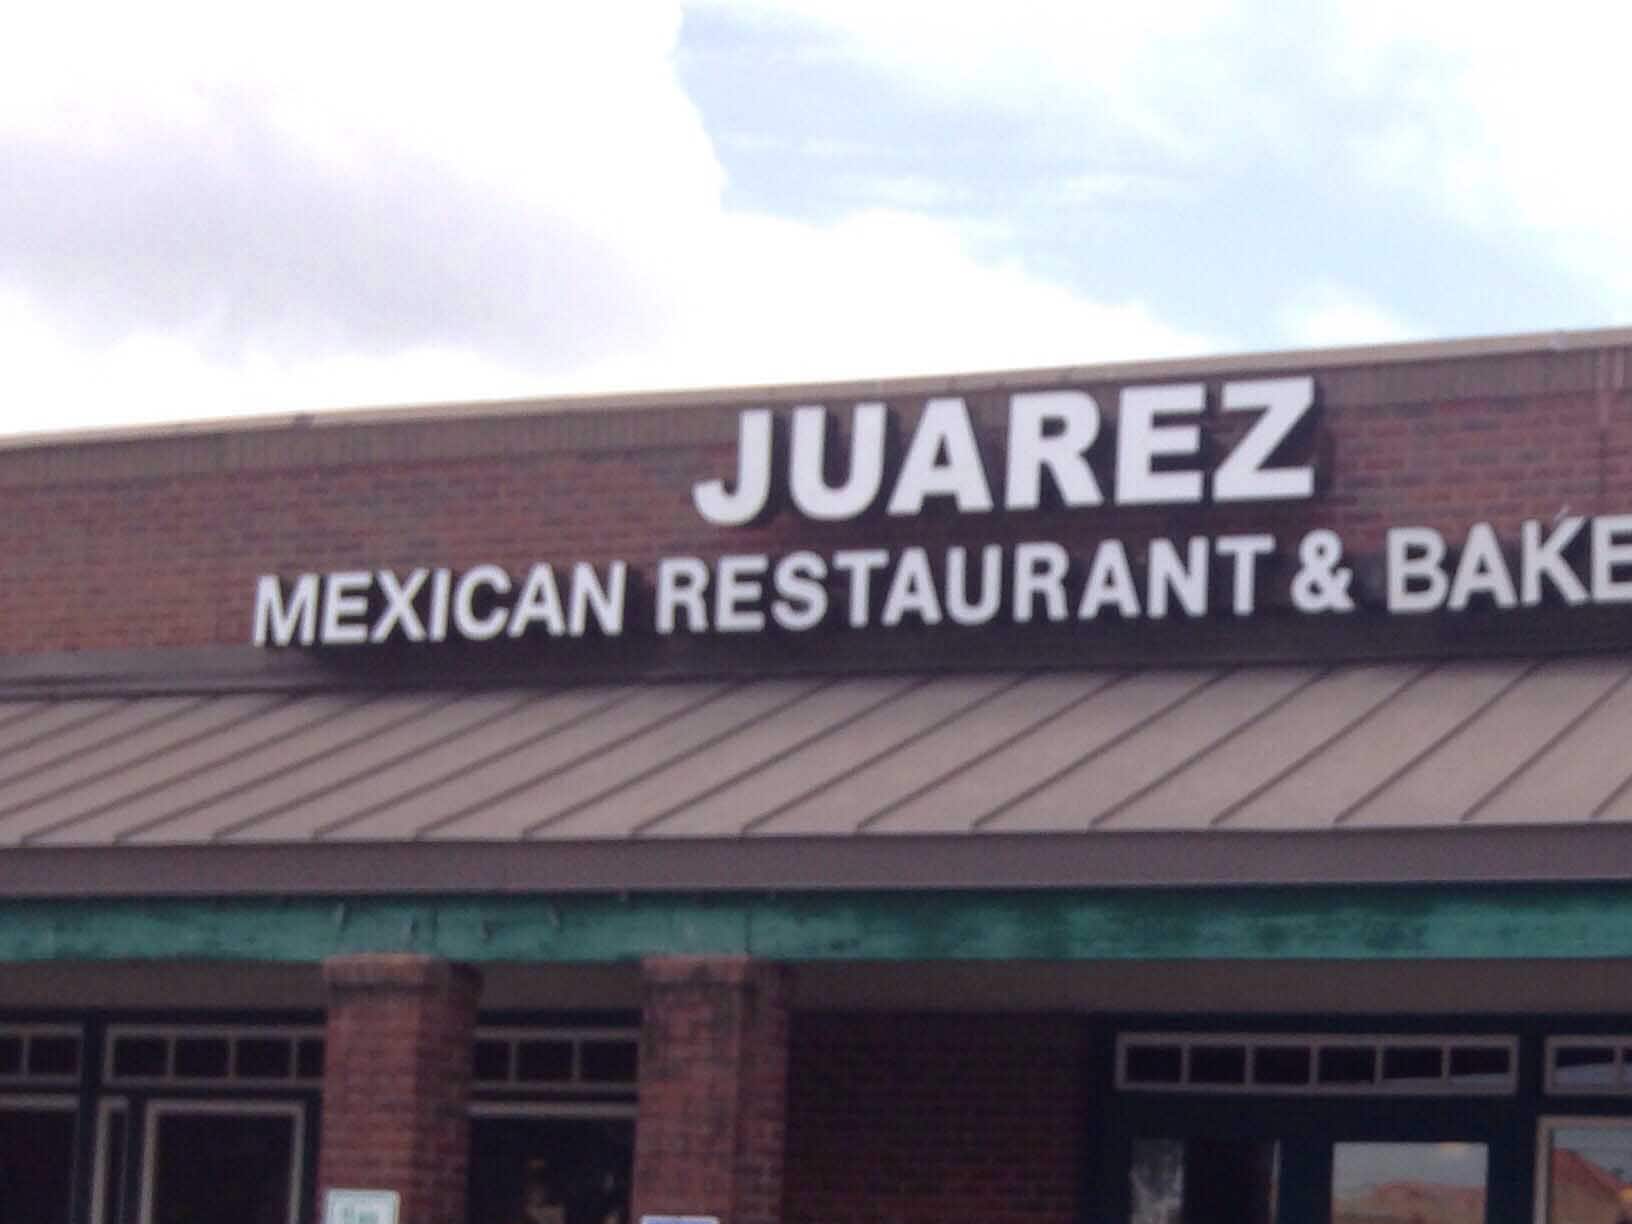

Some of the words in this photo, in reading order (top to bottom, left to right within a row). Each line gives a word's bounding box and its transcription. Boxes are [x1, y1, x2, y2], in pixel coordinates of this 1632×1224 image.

[693, 376, 1315, 525] JUAREZ
[251, 558, 627, 648] MEXICAN
[655, 534, 1276, 634] RESTAURANT
[1290, 529, 1355, 613] &
